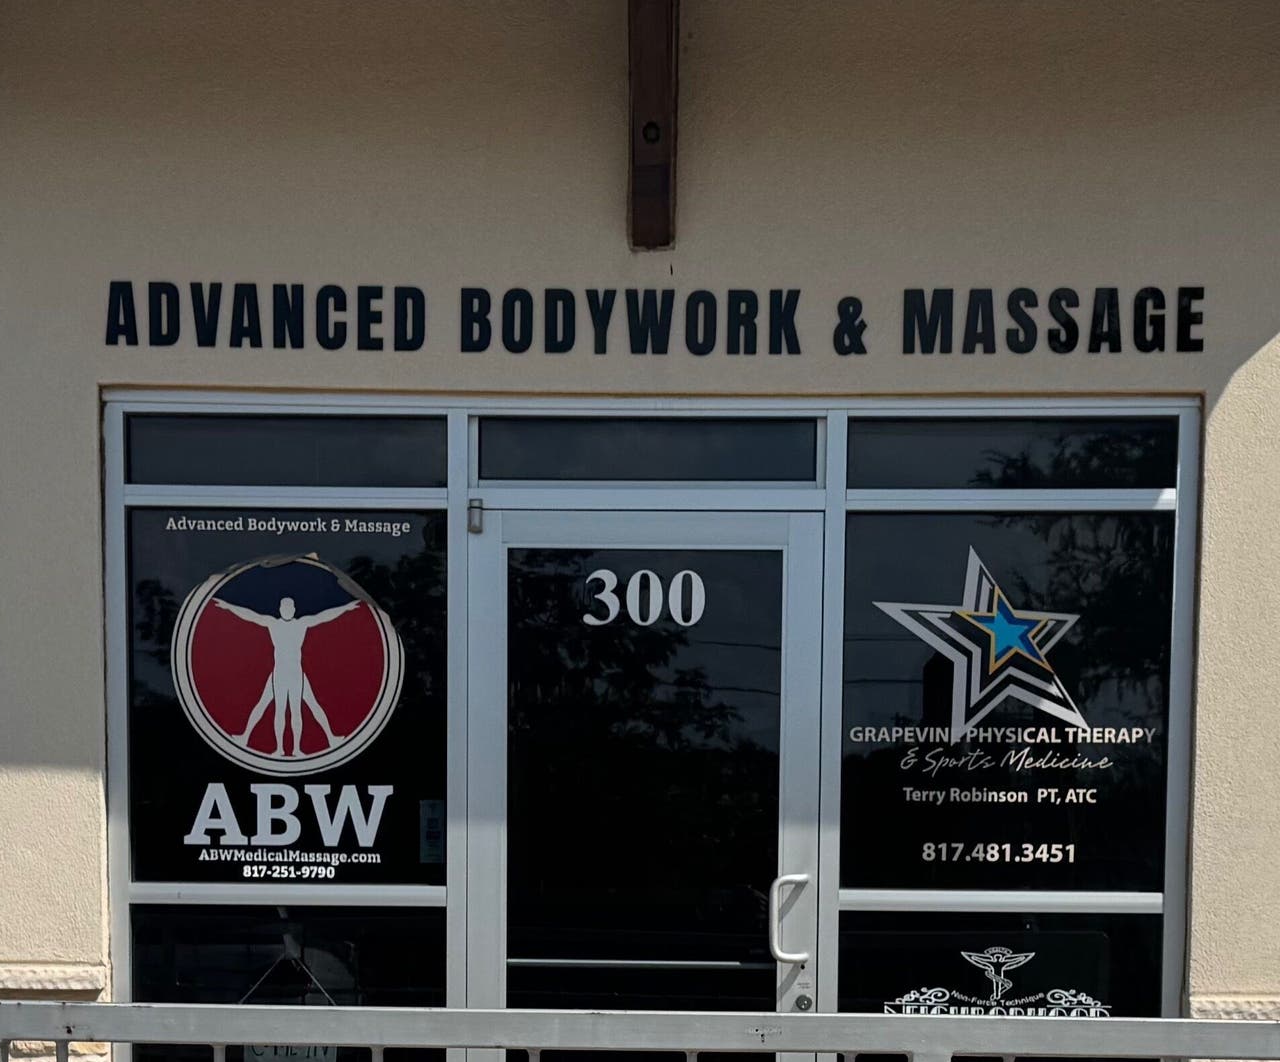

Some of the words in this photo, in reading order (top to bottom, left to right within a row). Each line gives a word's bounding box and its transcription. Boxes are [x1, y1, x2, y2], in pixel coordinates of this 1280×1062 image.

[105, 281, 426, 352] ADVANCED
[460, 288, 802, 356] BODYWORK
[832, 296, 868, 356] &
[902, 286, 1206, 355] MASSAGE
[166, 517, 244, 531] Advanced
[247, 518, 327, 534] Bodywork
[331, 519, 341, 531] &
[344, 520, 411, 536] Massage
[582, 568, 706, 627] 300
[849, 726, 961, 744] GRAPEVIN
[965, 727, 1062, 743] PHYSICAL
[1064, 727, 1156, 744] THERAPY
[900, 747, 919, 770] &
[922, 747, 996, 778] Sports
[1000, 746, 1114, 772] Medicine
[902, 787, 946, 805] Terry
[949, 787, 1028, 802] Robinson
[1037, 788, 1061, 805] PT,
[1064, 788, 1097, 803] ATC
[183, 782, 394, 848] ABW
[198, 849, 381, 865] ABWMedicalMassage.com
[921, 842, 1075, 863] 817.481.3451
[242, 865, 335, 879] 817-251-9790
